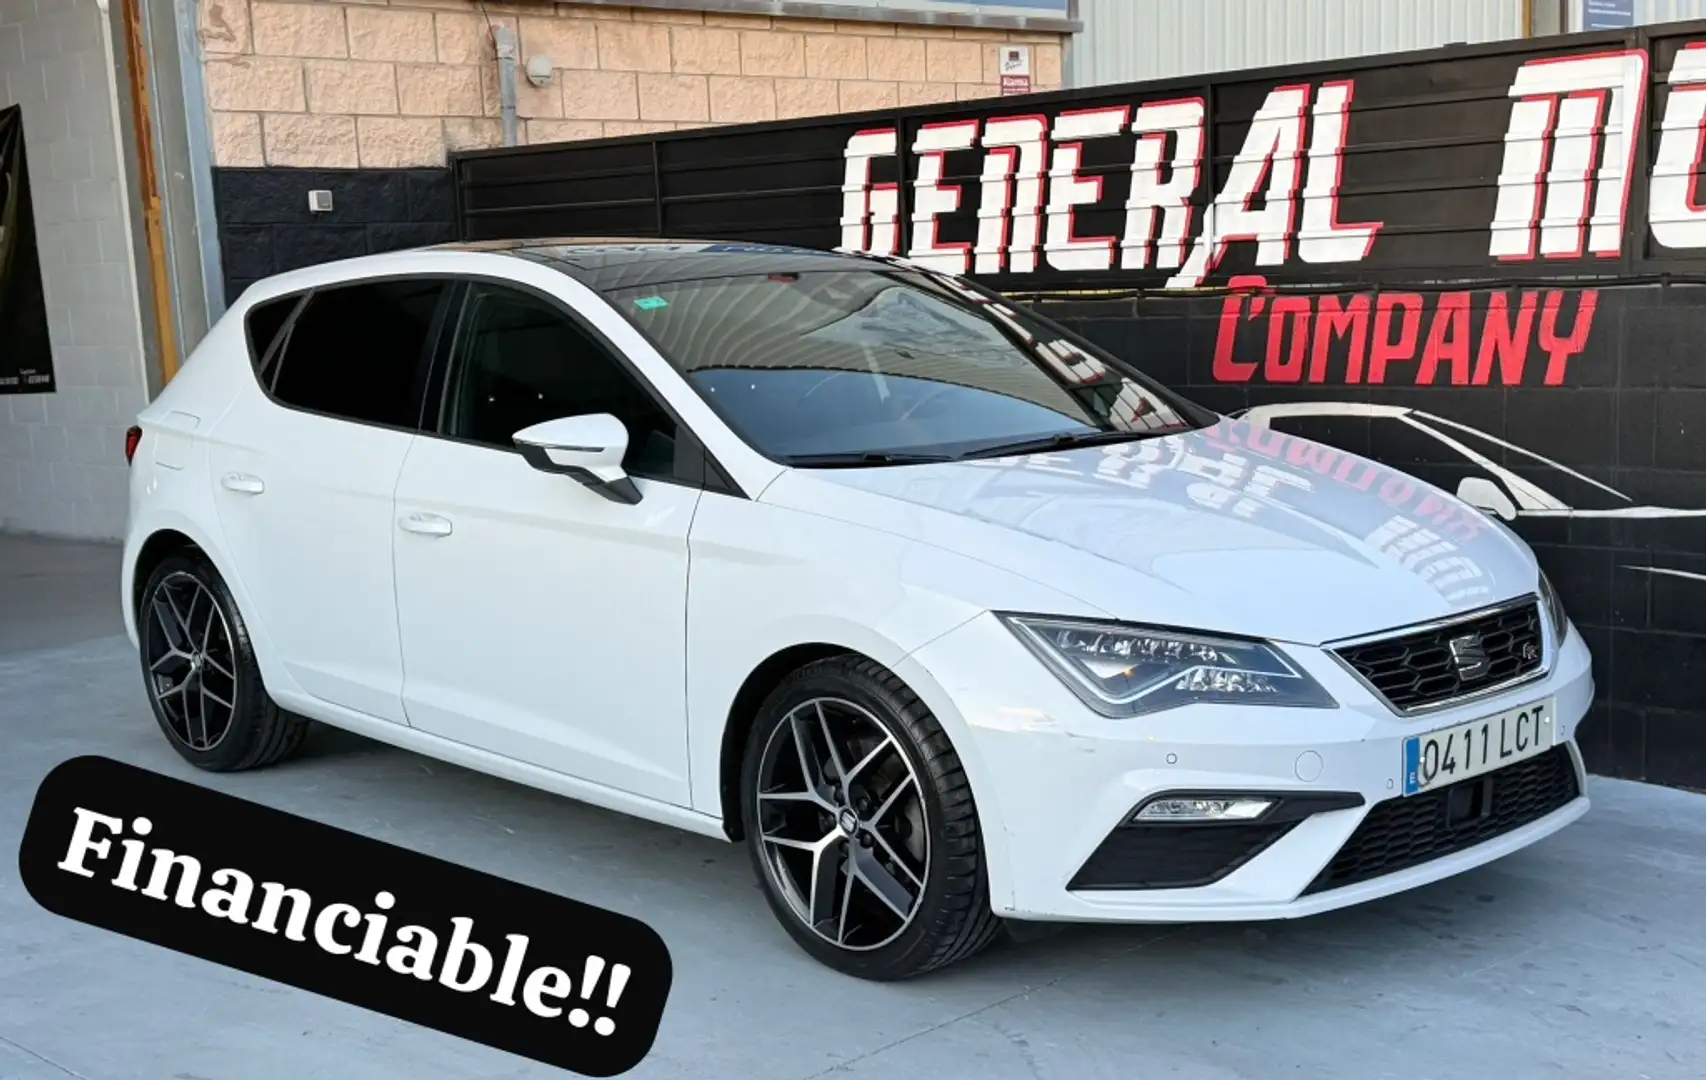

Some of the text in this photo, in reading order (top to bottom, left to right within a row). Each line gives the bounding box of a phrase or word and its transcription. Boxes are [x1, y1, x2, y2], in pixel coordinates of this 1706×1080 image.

[839, 78, 1384, 291] GENERAL
[1212, 275, 1598, 386] COMPANY
[1422, 723, 1489, 781] 0411
[1500, 704, 1544, 759] LCT
